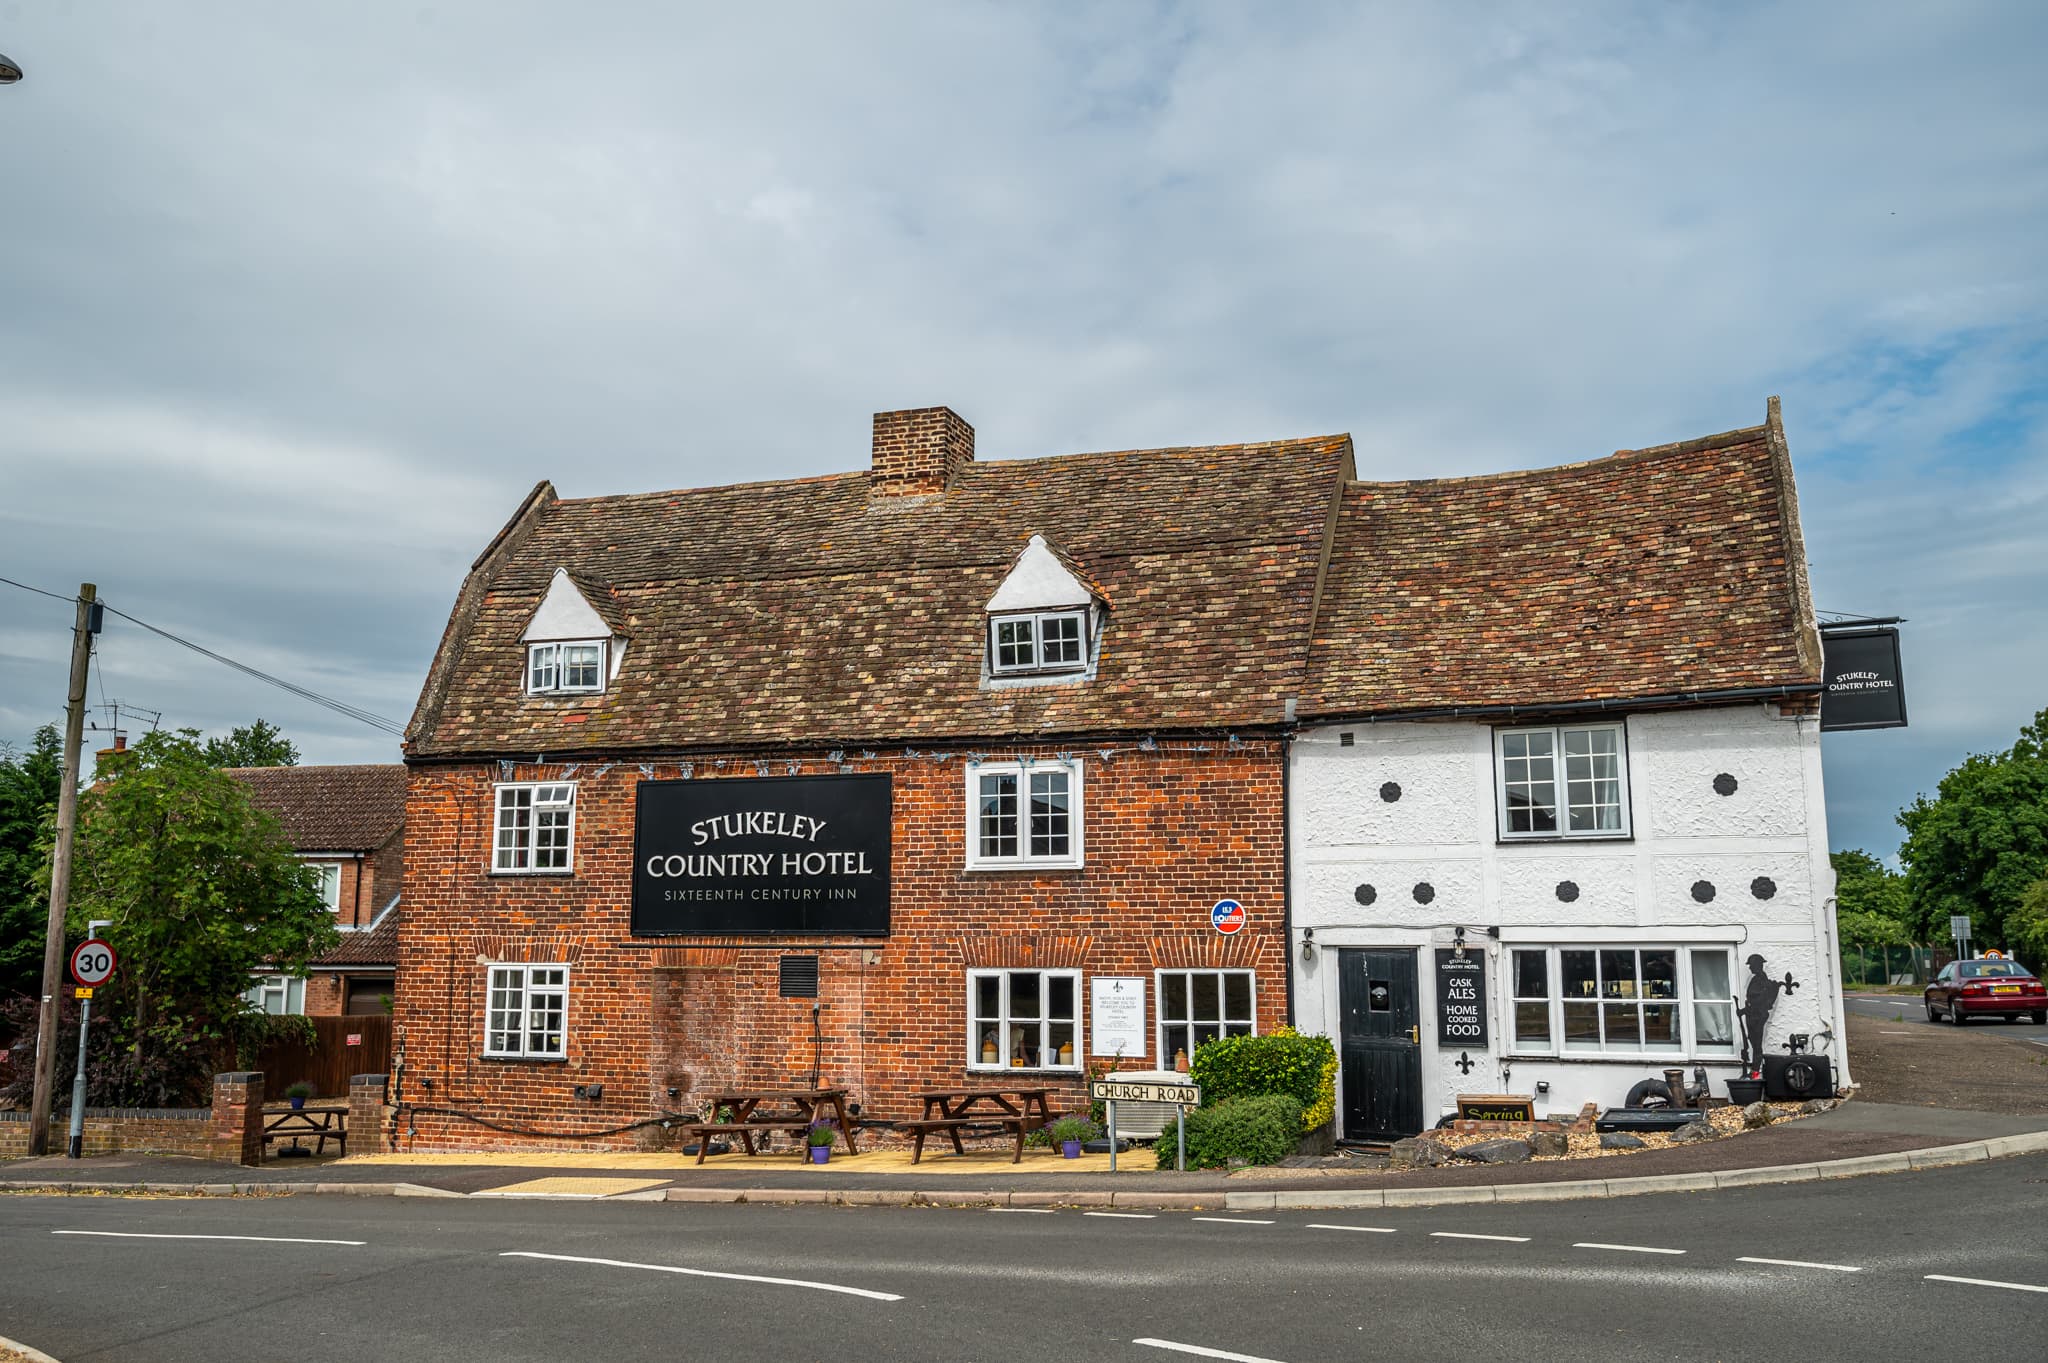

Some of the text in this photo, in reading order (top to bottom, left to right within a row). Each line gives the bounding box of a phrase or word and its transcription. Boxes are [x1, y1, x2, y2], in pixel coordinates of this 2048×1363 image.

[1836, 671, 1879, 683] STUKELEY
[1829, 679, 1894, 691] OUNTRY HOTEL
[691, 811, 827, 846] STUKELEY
[646, 851, 872, 878] COUNTRY HOTEL
[664, 888, 857, 901] SIXTEENTH CENTURY INN
[79, 953, 110, 973] 30
[1449, 978, 1472, 987] CASK
[1448, 988, 1476, 999] ALES
[1446, 1005, 1478, 1015] HOME
[1448, 1015, 1477, 1023] COOKED
[1446, 1024, 1480, 1036] FOOD
[1096, 1084, 1195, 1102] CHURCH ROAD
